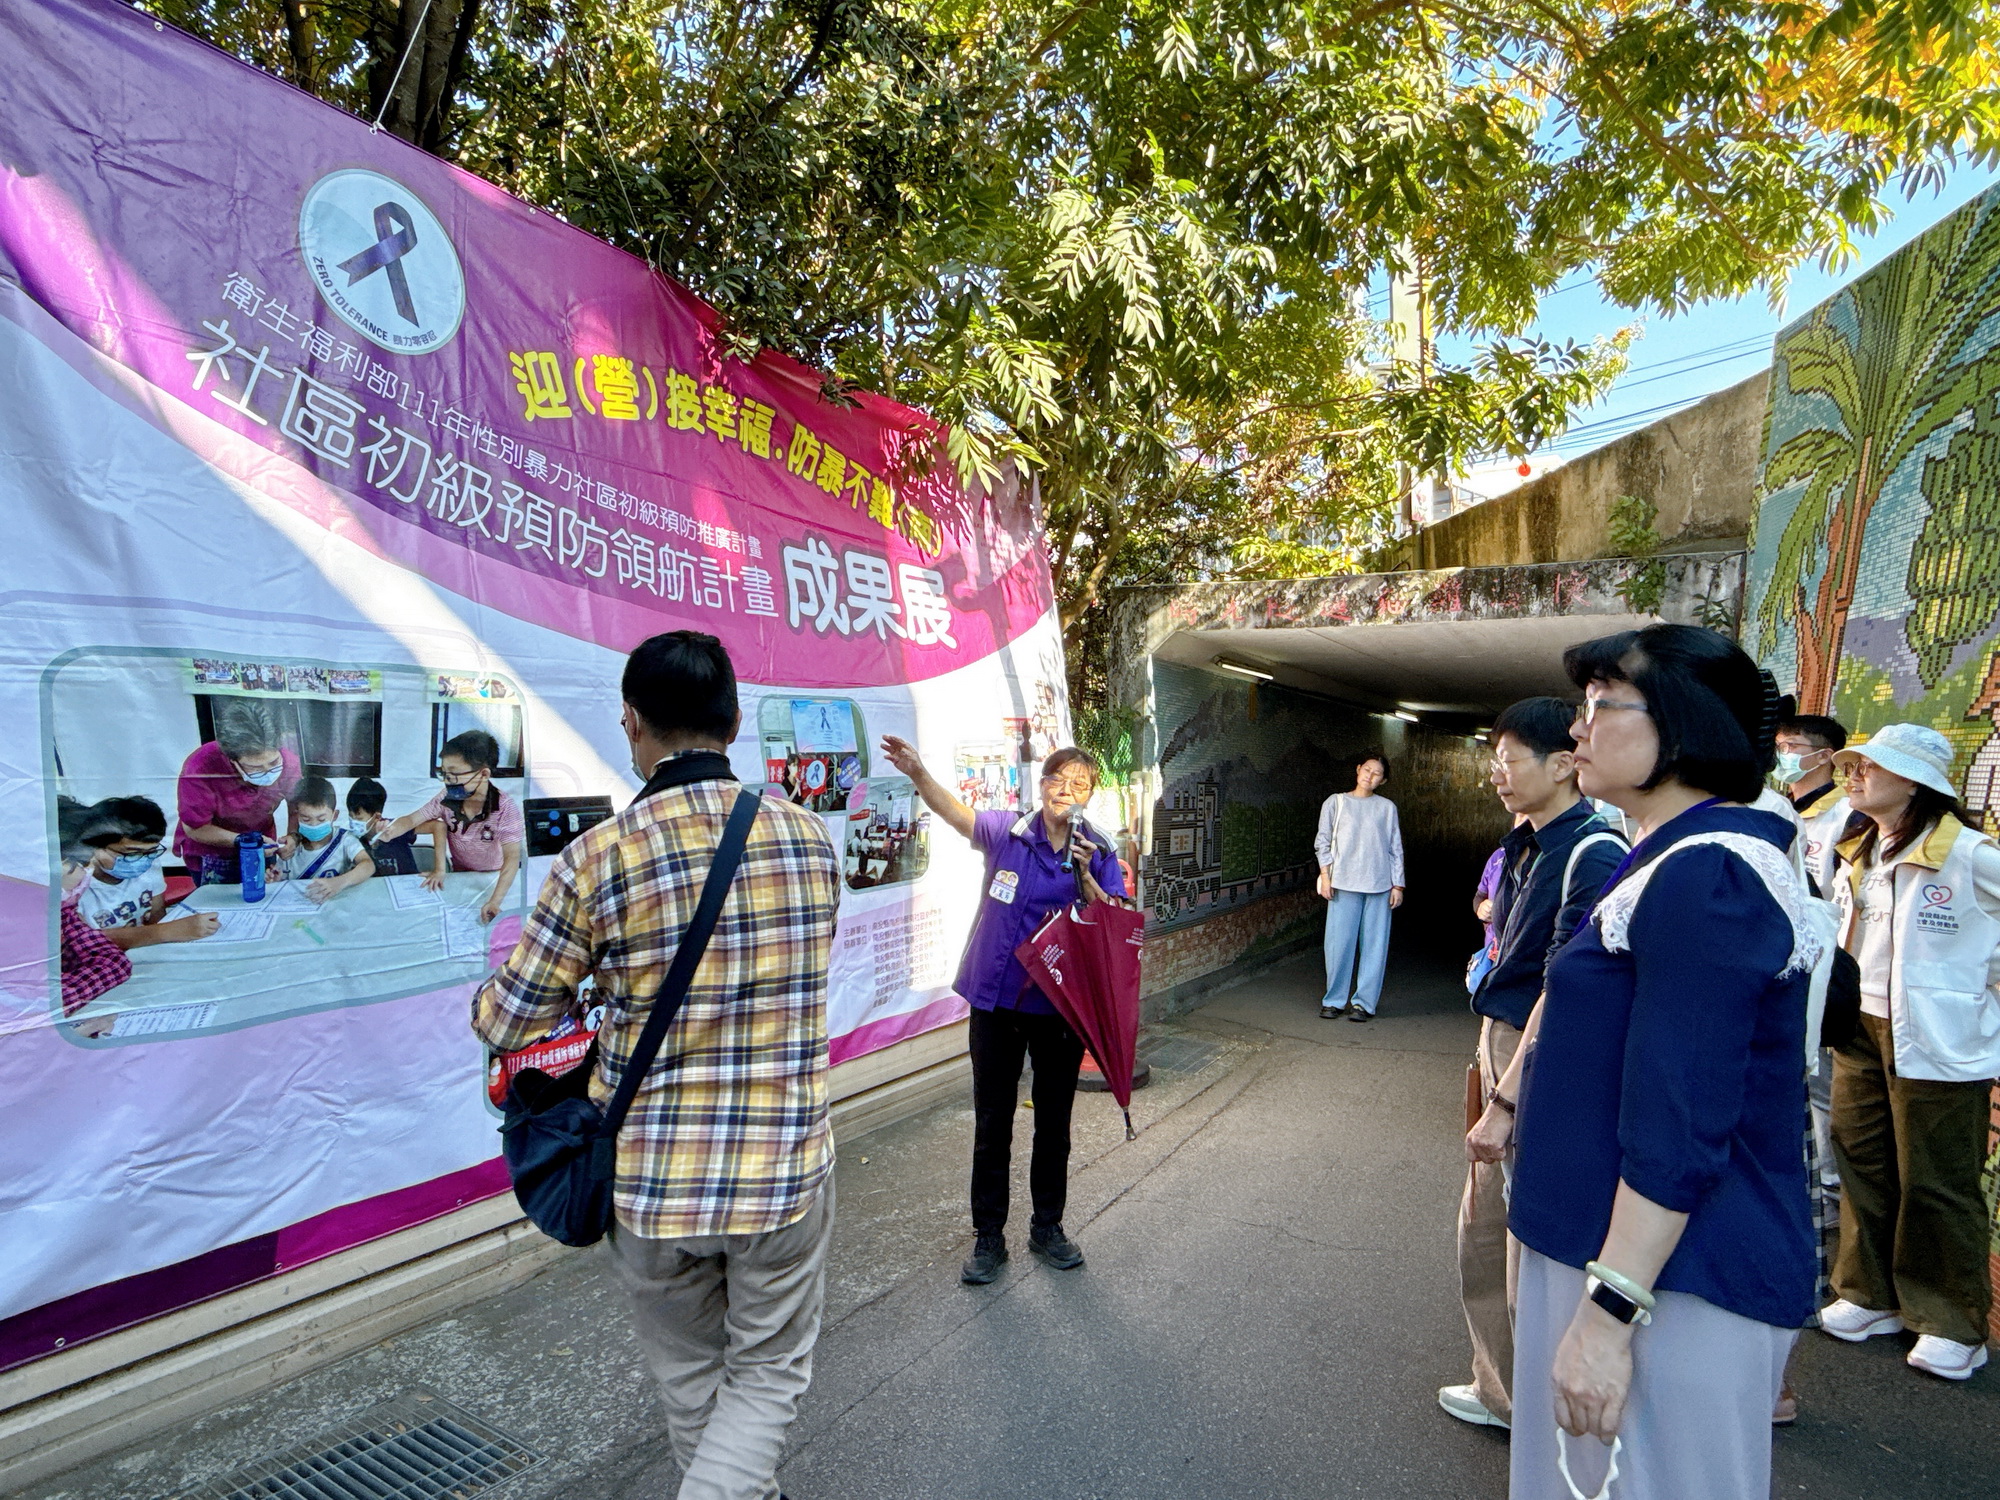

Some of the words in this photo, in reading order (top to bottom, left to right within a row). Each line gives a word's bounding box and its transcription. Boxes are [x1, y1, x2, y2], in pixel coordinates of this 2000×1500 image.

[222, 271, 763, 559] 衛生福利部111年性別暴力社區初級預防推廣計畫
[312, 256, 334, 288] ZERO
[330, 288, 389, 342] TOLERANCE
[186, 319, 779, 617] 社區初級預防領航計畫
[783, 537, 957, 650] 成果展
